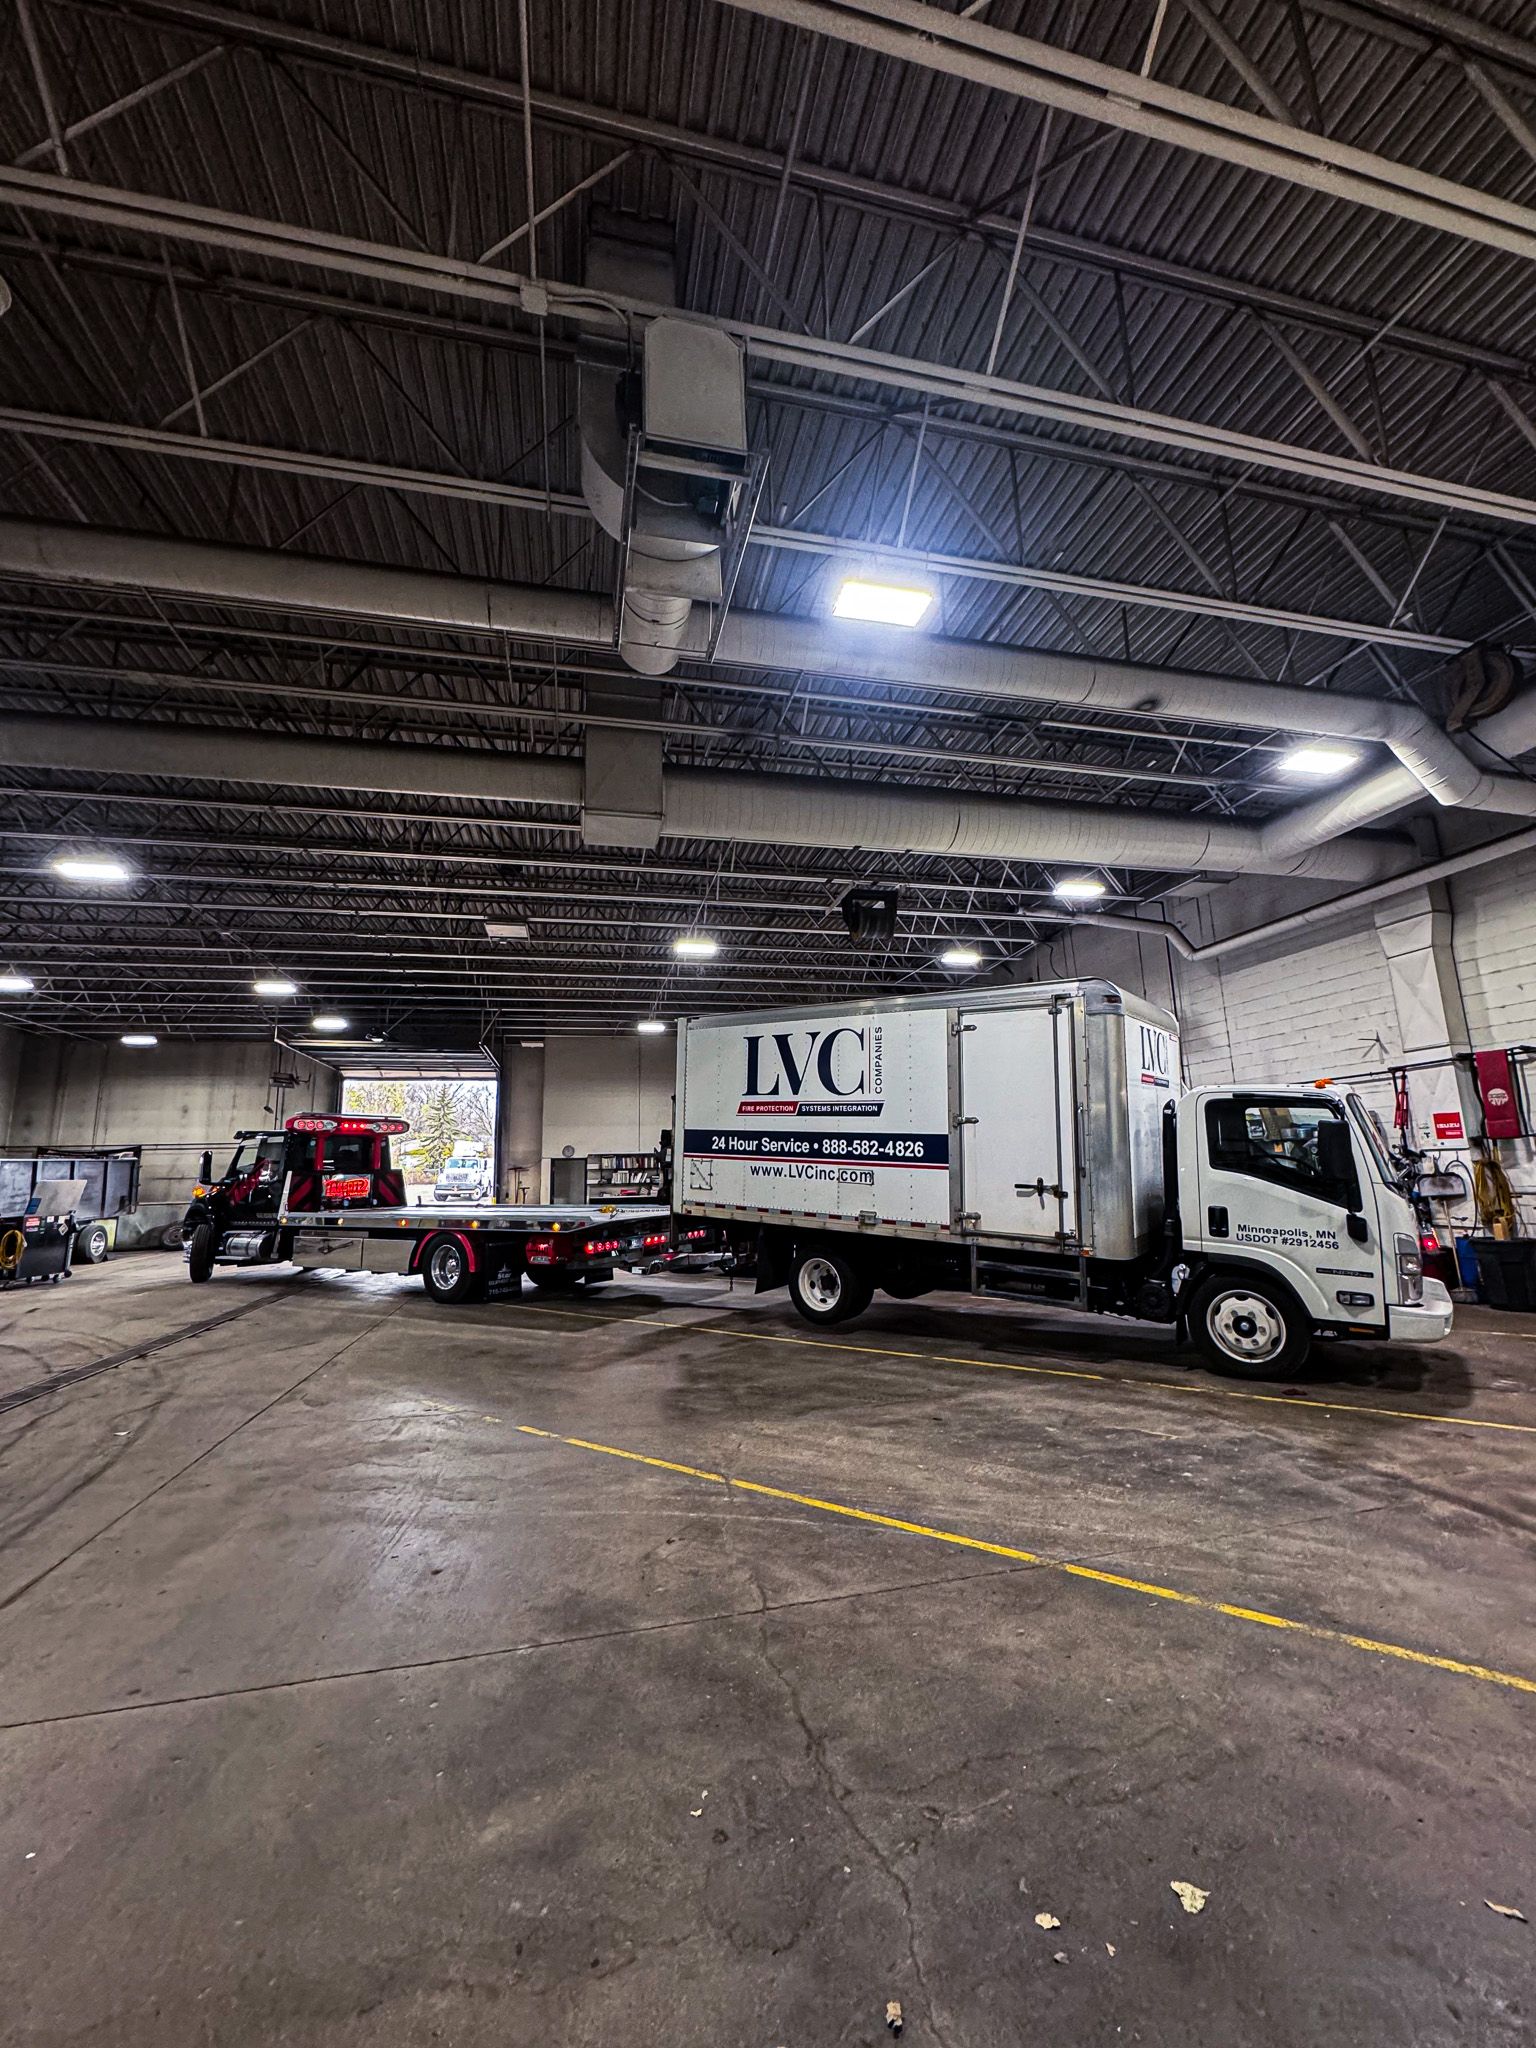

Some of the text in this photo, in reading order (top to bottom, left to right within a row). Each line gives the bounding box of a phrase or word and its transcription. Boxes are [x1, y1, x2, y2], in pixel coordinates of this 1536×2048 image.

[742, 1027, 864, 1096] LVC
[874, 1026, 882, 1094] COMPANIES
[711, 1136, 924, 1157] 24 Hour Service 888-582-4826
[750, 1165, 873, 1183] www.LVCinc.com
[1237, 1224, 1336, 1239] Minneapolis, MN
[1236, 1233, 1339, 1250] USDOT #2912456
